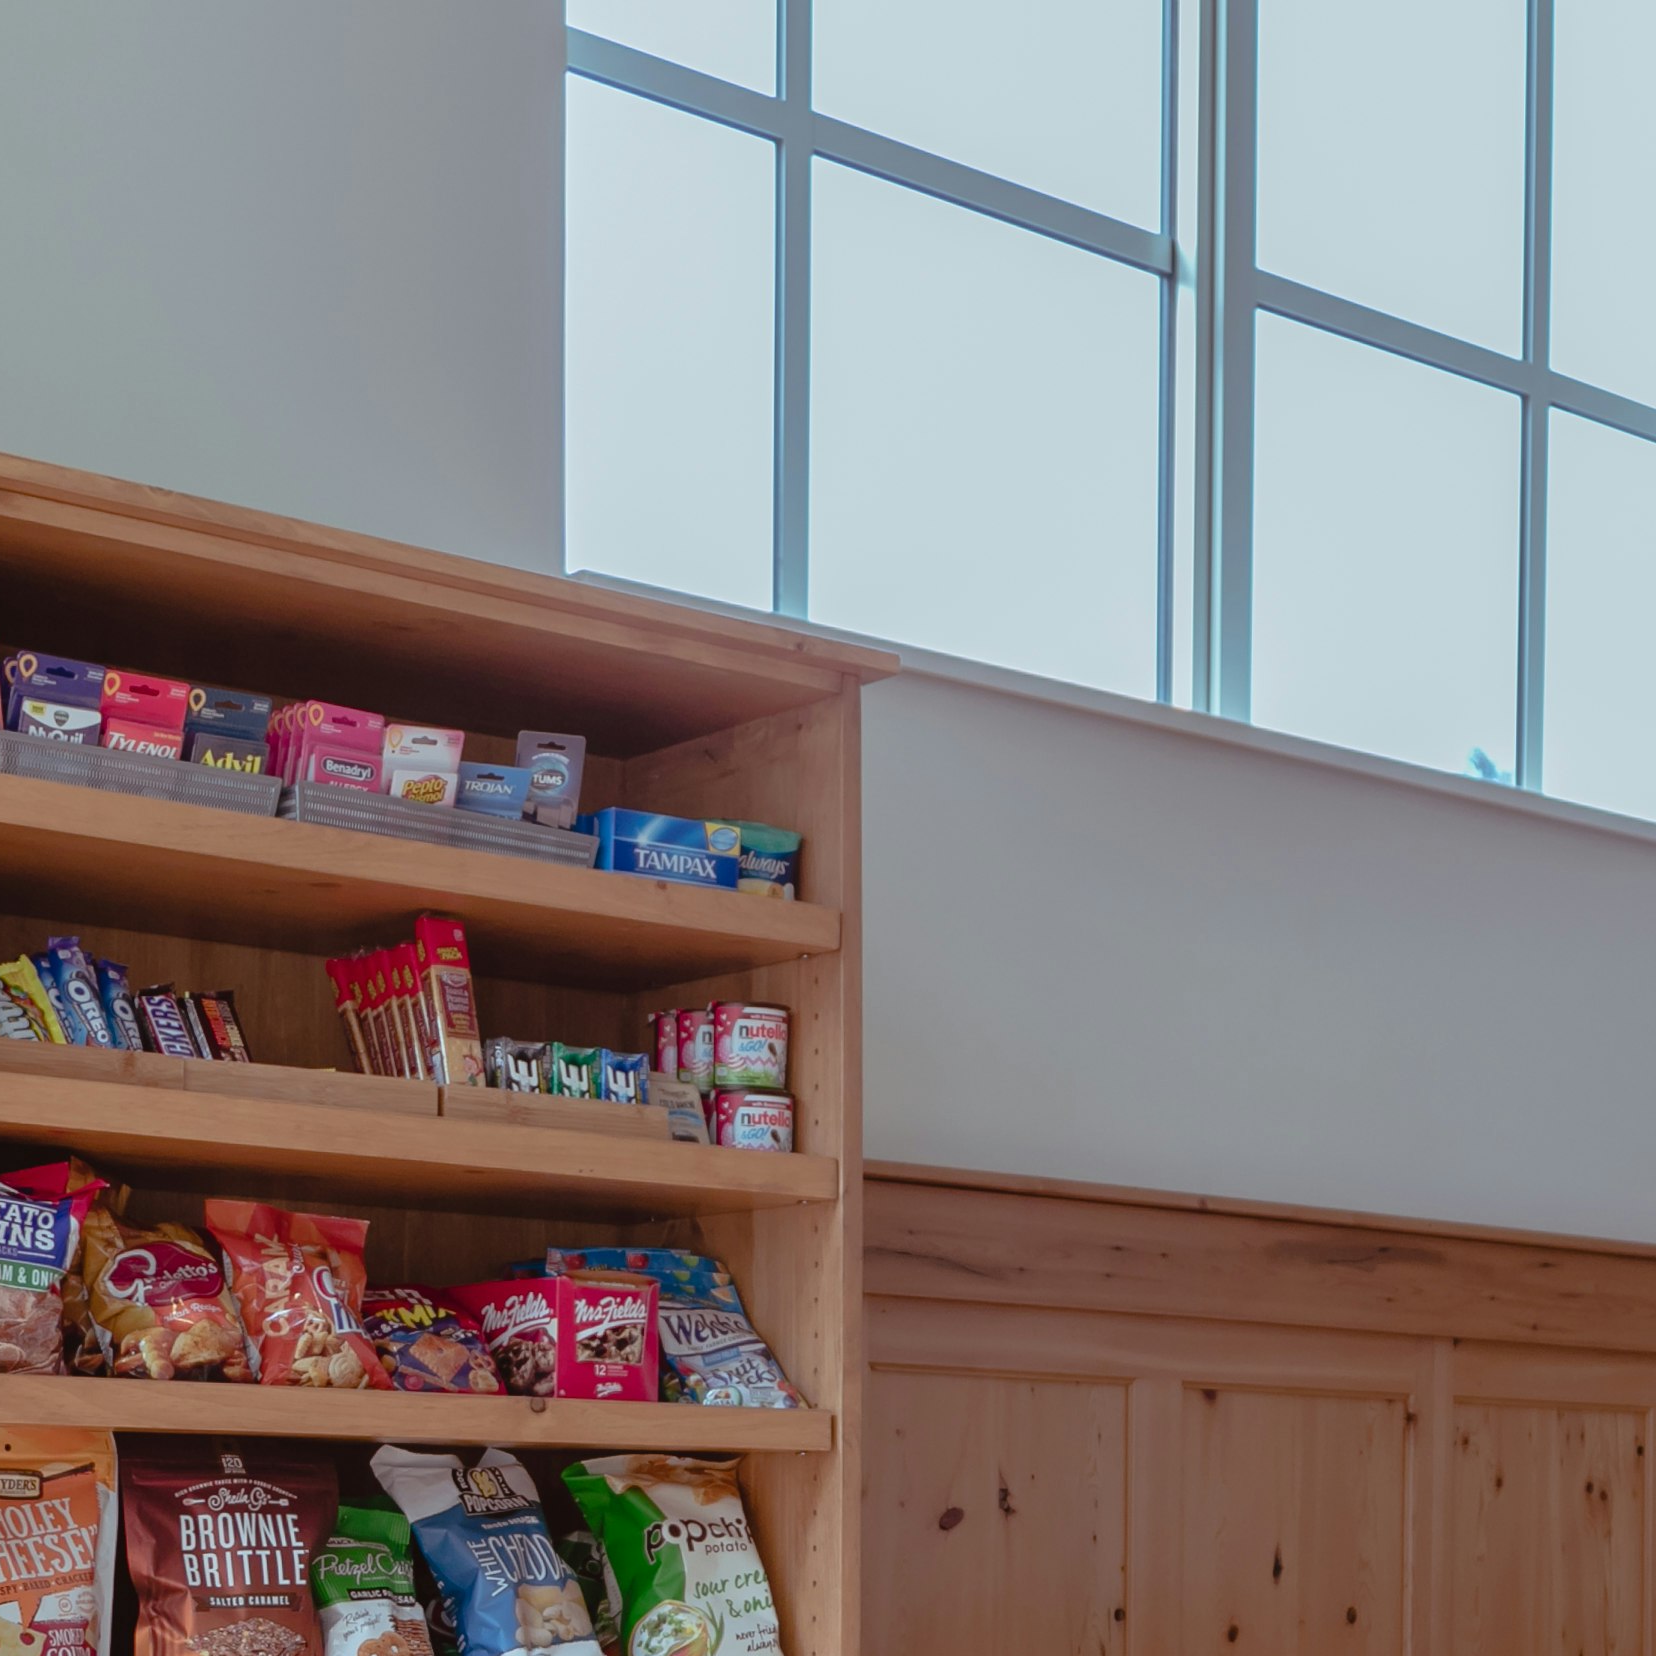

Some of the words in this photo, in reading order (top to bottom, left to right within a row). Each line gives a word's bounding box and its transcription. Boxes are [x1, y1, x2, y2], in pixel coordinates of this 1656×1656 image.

[108, 731, 178, 760] TYLENOL
[200, 748, 262, 774] Advil
[325, 758, 373, 780] Benadryl
[464, 780, 514, 795] TROJAN
[532, 774, 563, 786] TUMS
[634, 848, 717, 879] TAMPAX
[738, 850, 790, 879] always
[65, 979, 110, 1044] OREO
[112, 997, 144, 1052] ORE
[148, 996, 195, 1058] CKERS
[739, 1024, 788, 1040] nutella
[740, 1111, 791, 1127] nutella
[17, 1266, 26, 1284] &
[594, 1364, 607, 1376] 12
[221, 1457, 243, 1469] 120
[464, 1495, 530, 1513] POPCORN
[179, 1512, 304, 1551] BROWNIE
[705, 1541, 748, 1555] potato
[183, 1550, 308, 1588] BRITTLE
[312, 1553, 376, 1585] Pretzel
[466, 1538, 509, 1597] WHITE
[24, 1578, 51, 1591] BAKED
[350, 1589, 382, 1600] GARLIC
[693, 1577, 729, 1600] sour
[209, 1596, 244, 1606] SALTED
[248, 1595, 290, 1606] CARAMEL
[725, 1599, 742, 1618] &
[744, 1590, 773, 1613] oni
[47, 1628, 85, 1647] SMOKED
